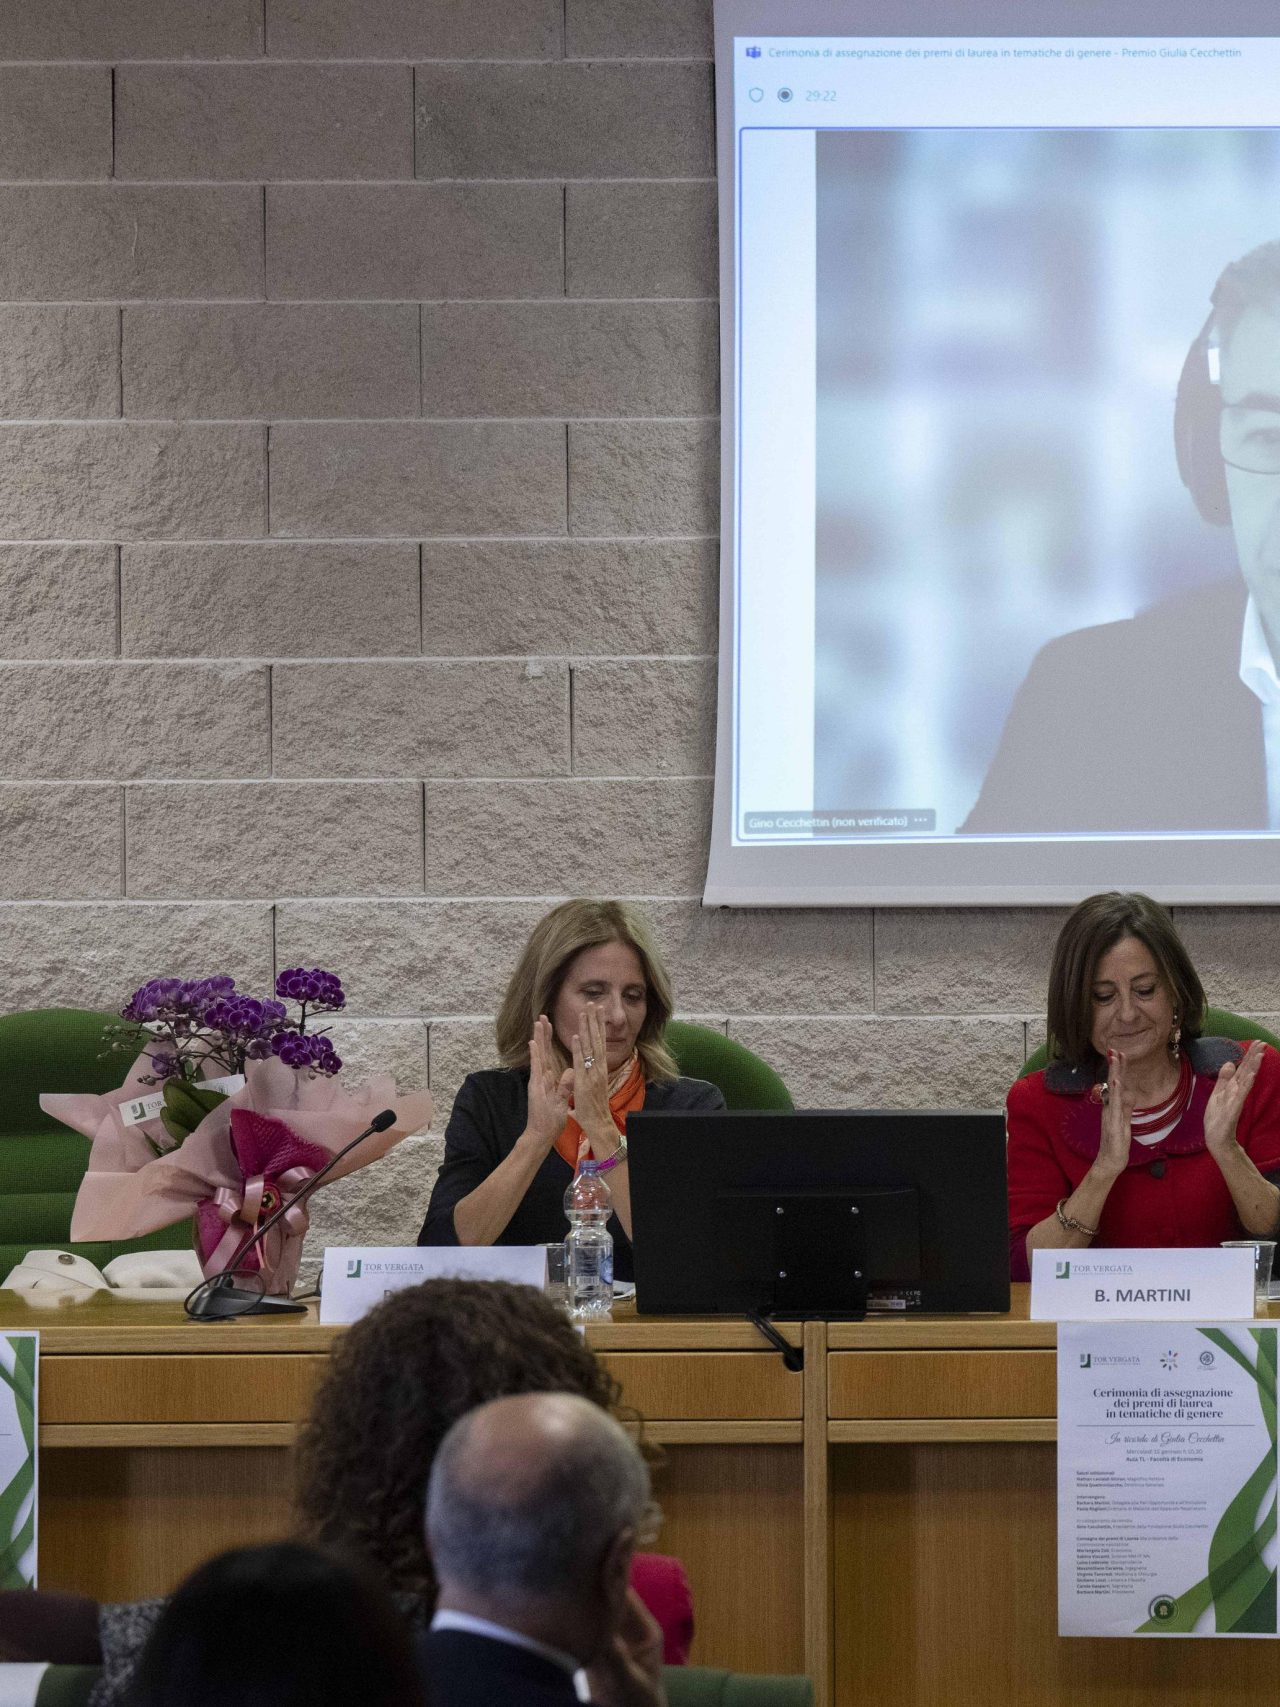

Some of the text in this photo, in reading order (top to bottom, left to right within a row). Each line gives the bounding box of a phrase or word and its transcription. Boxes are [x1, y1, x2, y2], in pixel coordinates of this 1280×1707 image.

[768, 48, 820, 58] Cerimonia
[823, 48, 832, 58] di
[835, 50, 902, 60] assegnazione
[906, 48, 920, 58] dei
[924, 49, 952, 60] premi
[956, 48, 965, 58] di
[968, 48, 998, 58] laurea
[1001, 48, 1010, 58] in
[1014, 48, 1062, 58] tematiche
[1065, 48, 1074, 58] di
[1078, 50, 1112, 60] genere
[1122, 48, 1156, 58] Premio
[1160, 48, 1187, 58] Giulia
[1190, 48, 1242, 58] Cecchettin
[749, 816, 908, 828] Gino Cecchettin (non verificato)
[1073, 1264, 1132, 1272] TOR VERGATA
[1095, 1288, 1190, 1302] B. MARTINI
[1093, 1388, 1233, 1400] Cerimonia di assegnazione
[1113, 1399, 1213, 1410] dei premi di laurea
[1106, 1409, 1224, 1420] in tematiche di genere
[1124, 1434, 1149, 1444] ricordo
[1151, 1432, 1158, 1444] di
[1160, 1432, 1185, 1447] Giulia
